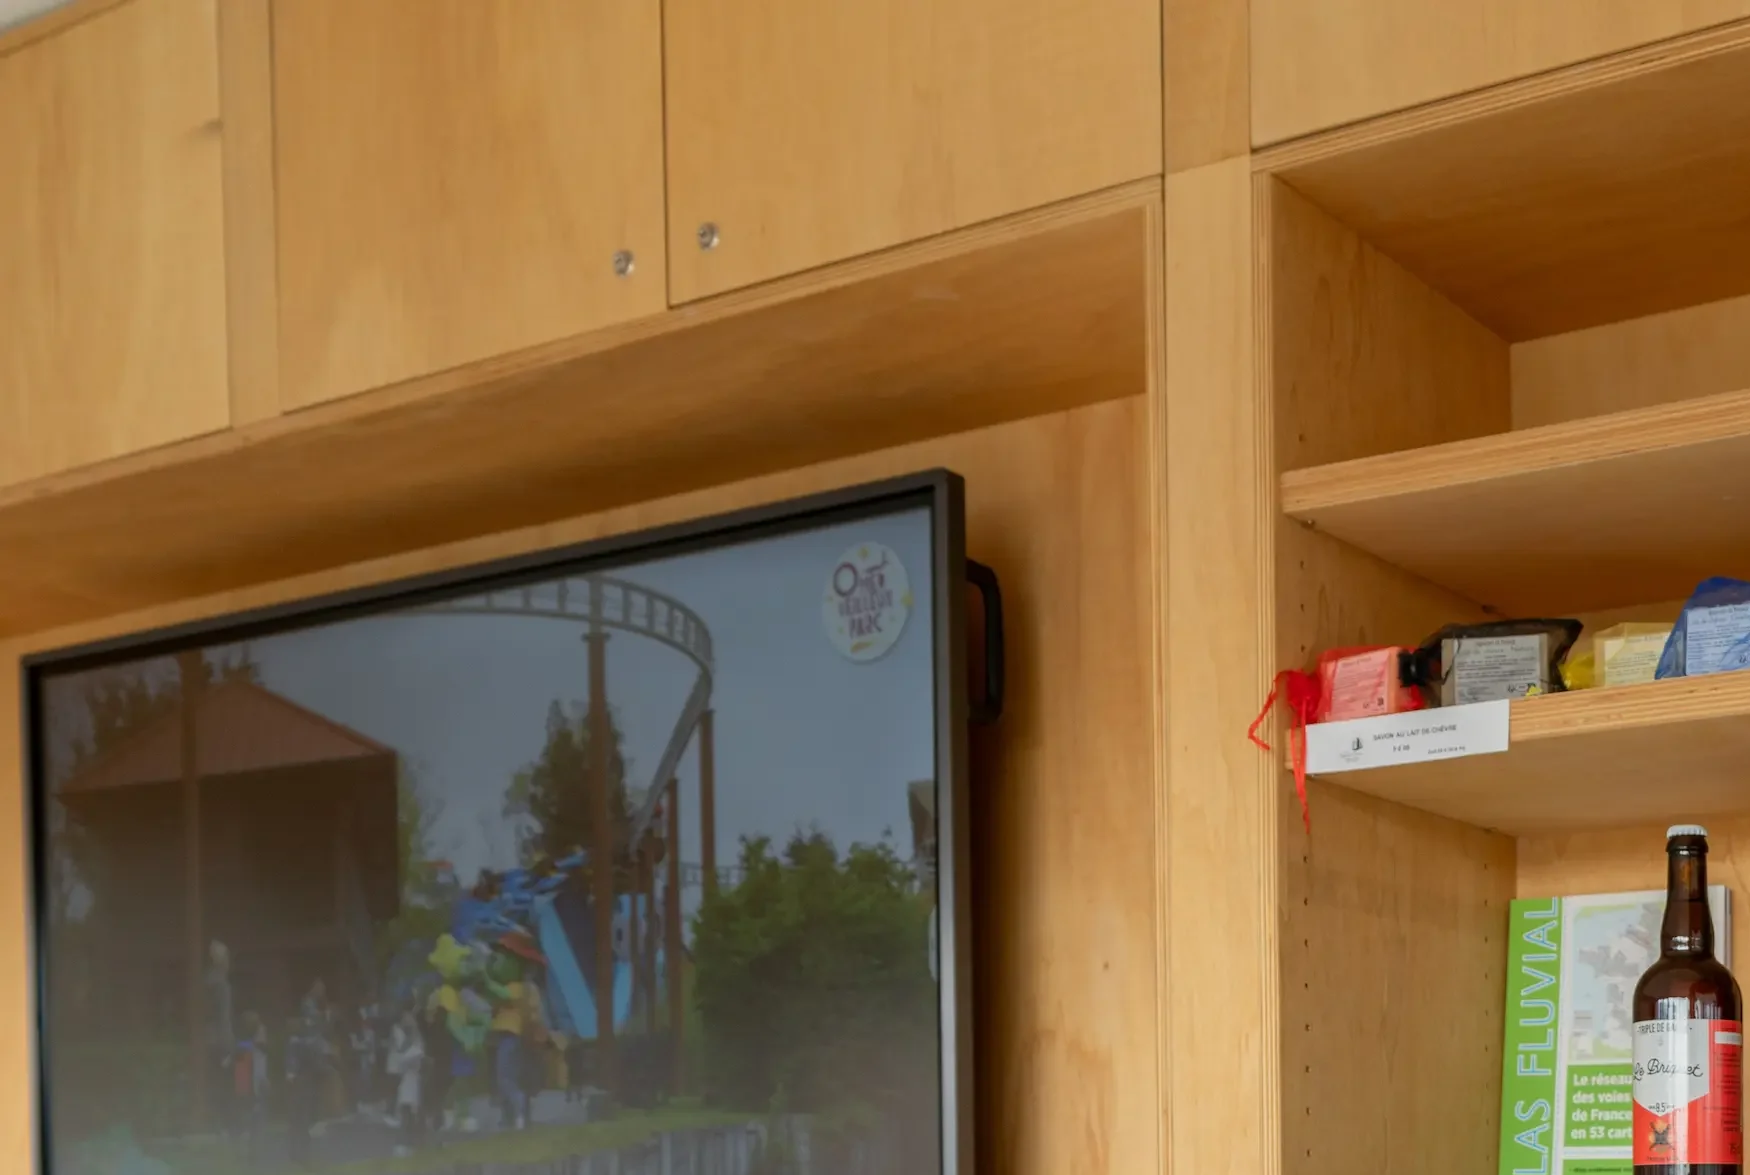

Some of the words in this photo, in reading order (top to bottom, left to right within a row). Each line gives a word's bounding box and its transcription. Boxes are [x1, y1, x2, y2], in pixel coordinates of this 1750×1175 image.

[1517, 896, 1558, 1077] FLUVIAL
[1573, 1074, 1588, 1087] Le
[1572, 1091, 1594, 1105] des
[1597, 1091, 1631, 1105] voies
[1571, 1110, 1588, 1122] de
[1591, 1109, 1632, 1122] France
[1570, 1128, 1586, 1139] en
[1588, 1126, 1605, 1139] 53
